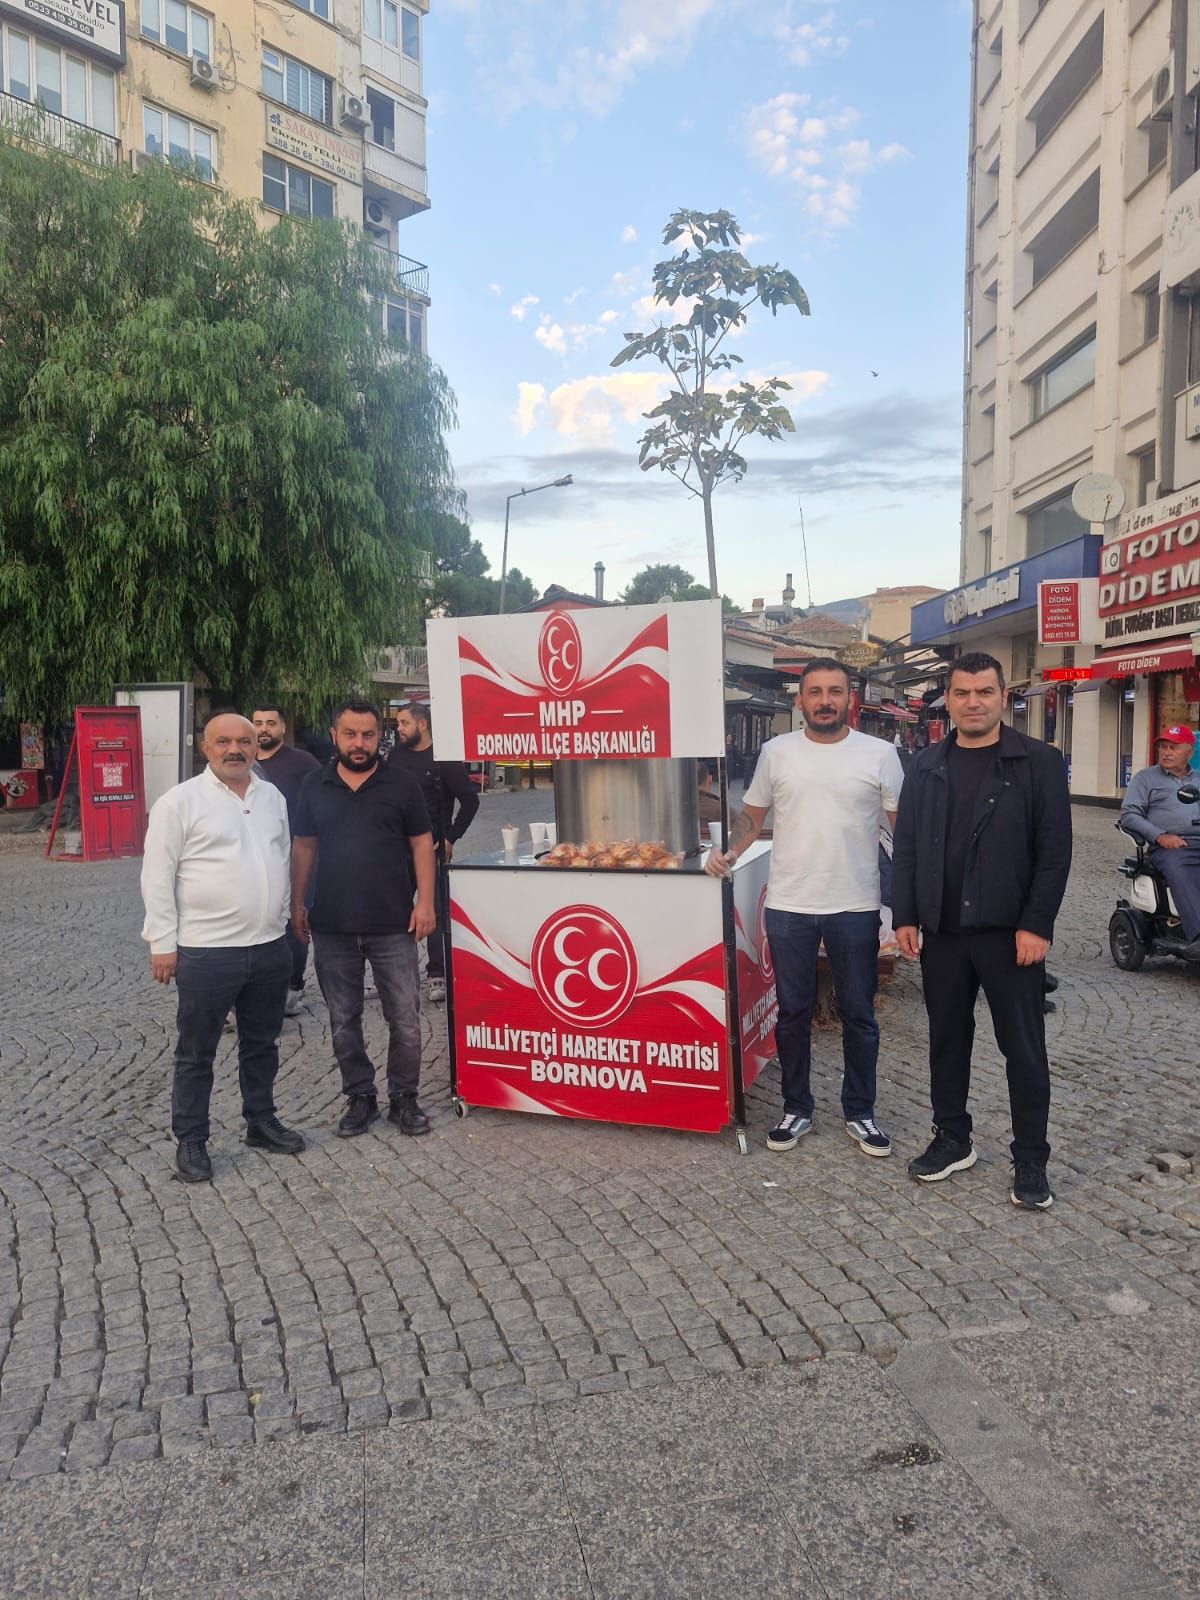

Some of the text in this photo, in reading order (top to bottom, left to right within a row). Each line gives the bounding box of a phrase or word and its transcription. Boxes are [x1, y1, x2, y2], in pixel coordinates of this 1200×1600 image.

[29, 1, 50, 15] 0533
[67, 18, 79, 29] 35
[64, 0, 115, 26] EVEL
[77, 10, 105, 30] Studio
[271, 126, 308, 148] Ekrem
[285, 118, 320, 144] SARAY
[273, 136, 288, 150] 388
[290, 144, 301, 156] 38
[302, 149, 313, 161] 68
[1126, 519, 1199, 564] FOTO
[1098, 557, 1200, 609] DİDEM
[1048, 595, 1072, 604] DİDEM
[1118, 656, 1161, 671] FOTO DİDEM
[539, 700, 586, 727] MHP
[477, 725, 655, 760] BORNOVA İLÇE BAŞKANLIĞI
[466, 1021, 719, 1071] MİLLİYETÇİ HAREKET PARTİSİ
[531, 1060, 647, 1093] BORNOVA
